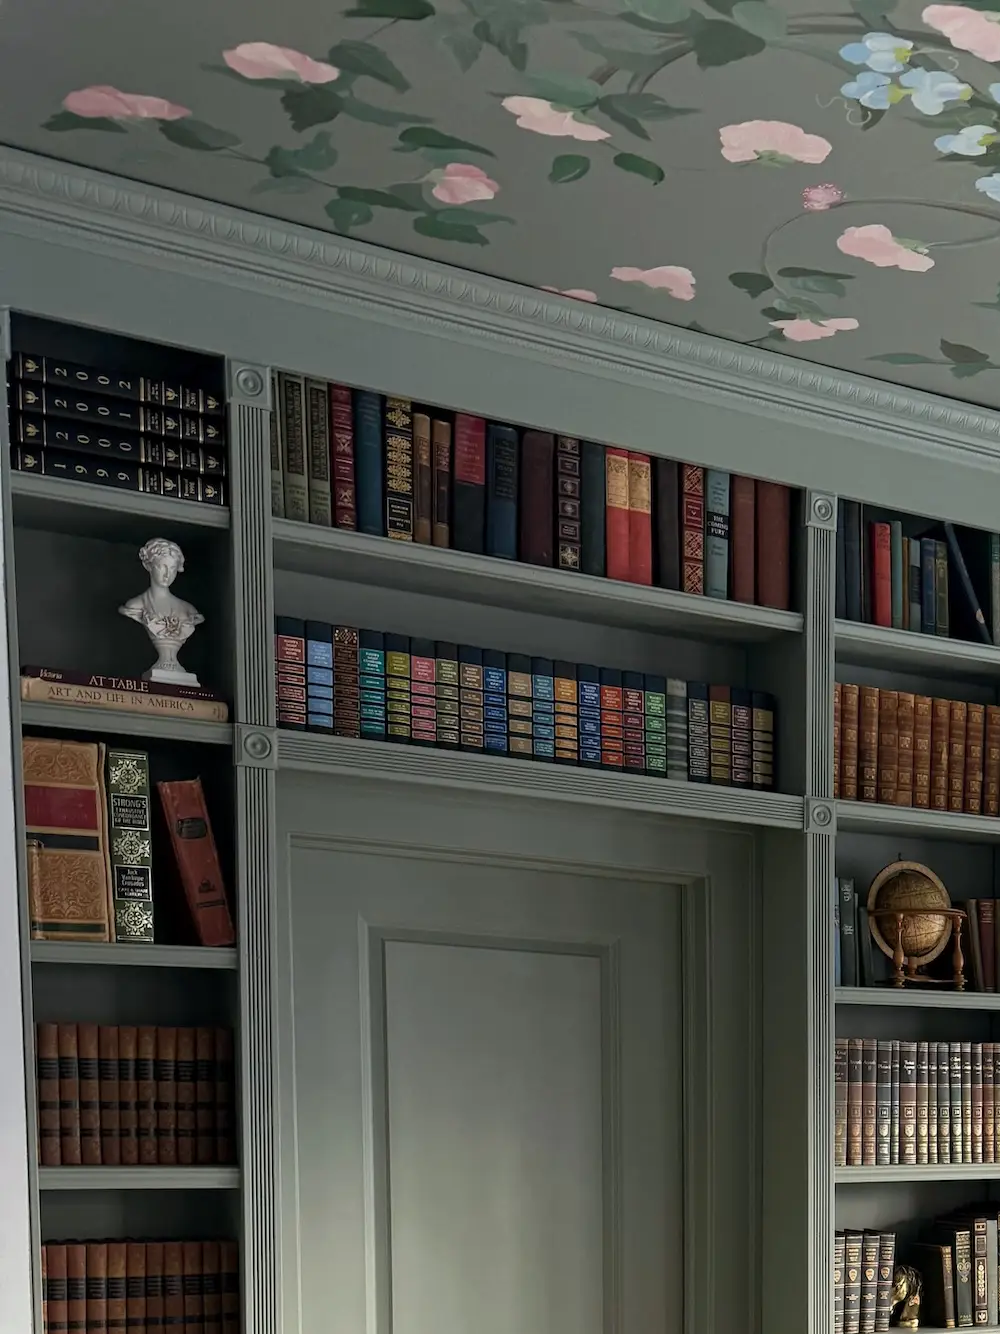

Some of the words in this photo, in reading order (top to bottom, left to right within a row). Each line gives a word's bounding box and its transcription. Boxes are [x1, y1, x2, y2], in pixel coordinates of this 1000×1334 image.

[54, 366, 132, 390] 2002
[54, 398, 132, 419] 2001
[55, 431, 133, 452] 2000
[54, 462, 131, 481] 1999
[707, 521, 729, 531] COMING
[713, 515, 723, 523] THE
[711, 527, 726, 536] FURY
[88, 675, 106, 687] AT
[107, 677, 149, 693] TABLE
[47, 686, 72, 697] ART
[76, 689, 102, 700] AND
[106, 692, 125, 704] LIFE
[131, 695, 142, 705] IN
[147, 697, 195, 711] AMERICA
[113, 798, 147, 808] STRONG'S
